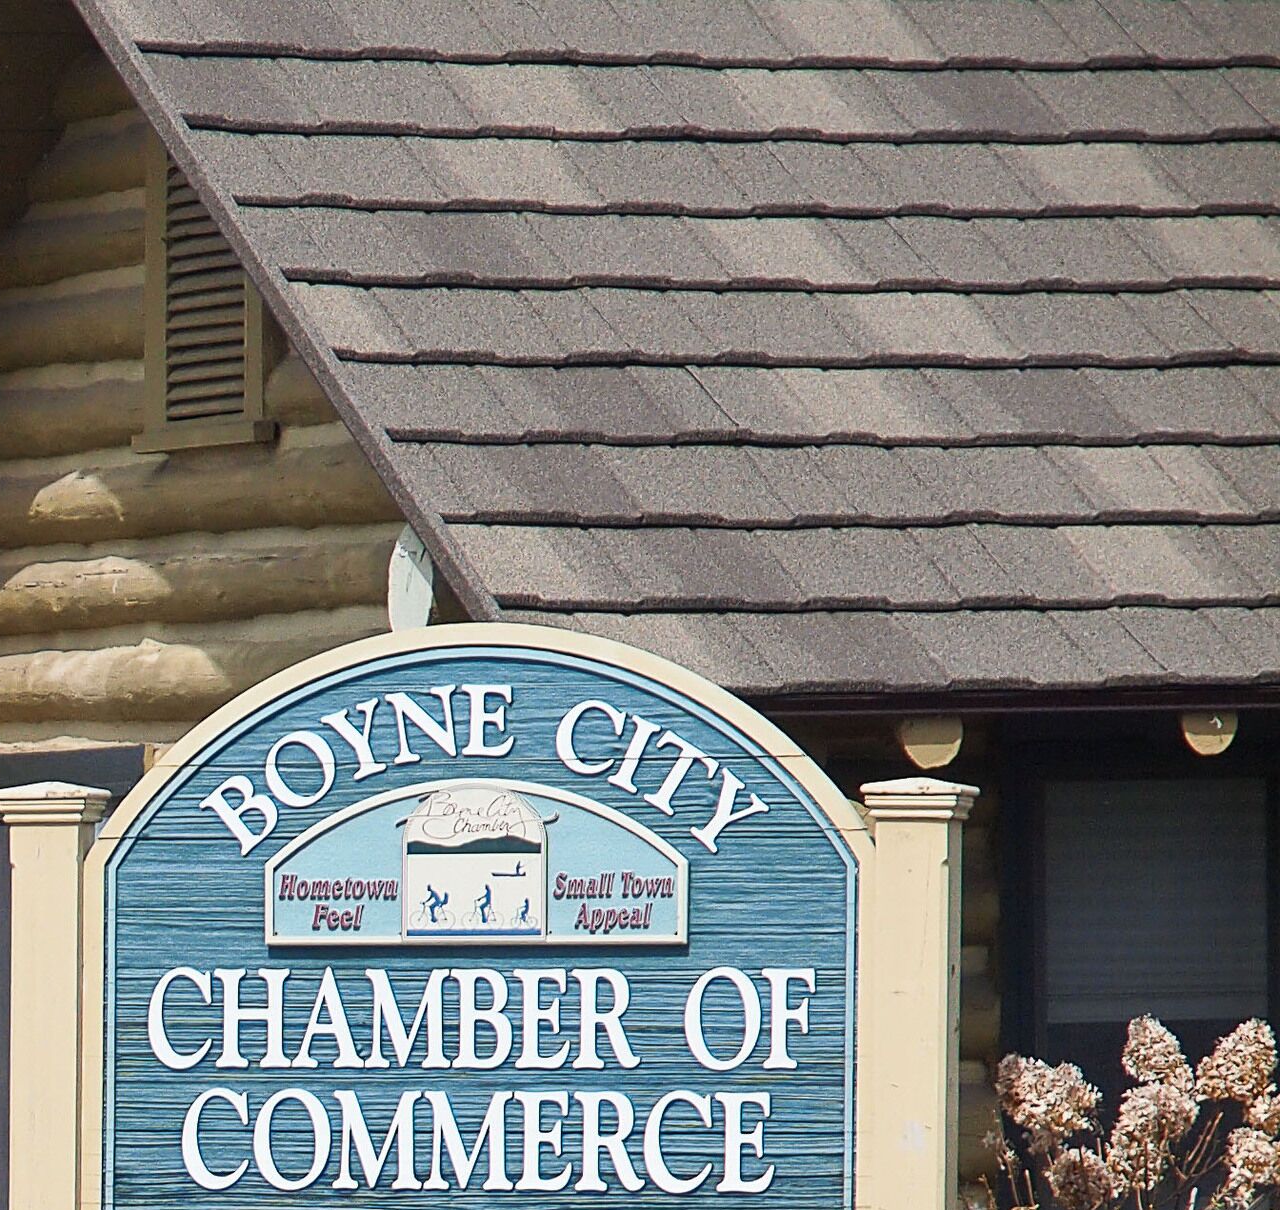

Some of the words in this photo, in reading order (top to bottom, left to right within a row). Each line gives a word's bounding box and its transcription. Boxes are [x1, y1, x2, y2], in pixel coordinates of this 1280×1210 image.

[199, 684, 514, 857] BOYNE
[556, 699, 771, 855] CITY
[279, 873, 399, 901] Hometown
[553, 871, 615, 900] Small
[621, 871, 674, 899] Town
[311, 903, 365, 931] Feel
[574, 902, 653, 934] Appeal
[148, 966, 641, 1070] CHAMBER
[684, 966, 816, 1071] OF
[181, 1087, 775, 1194] COMMERCE
